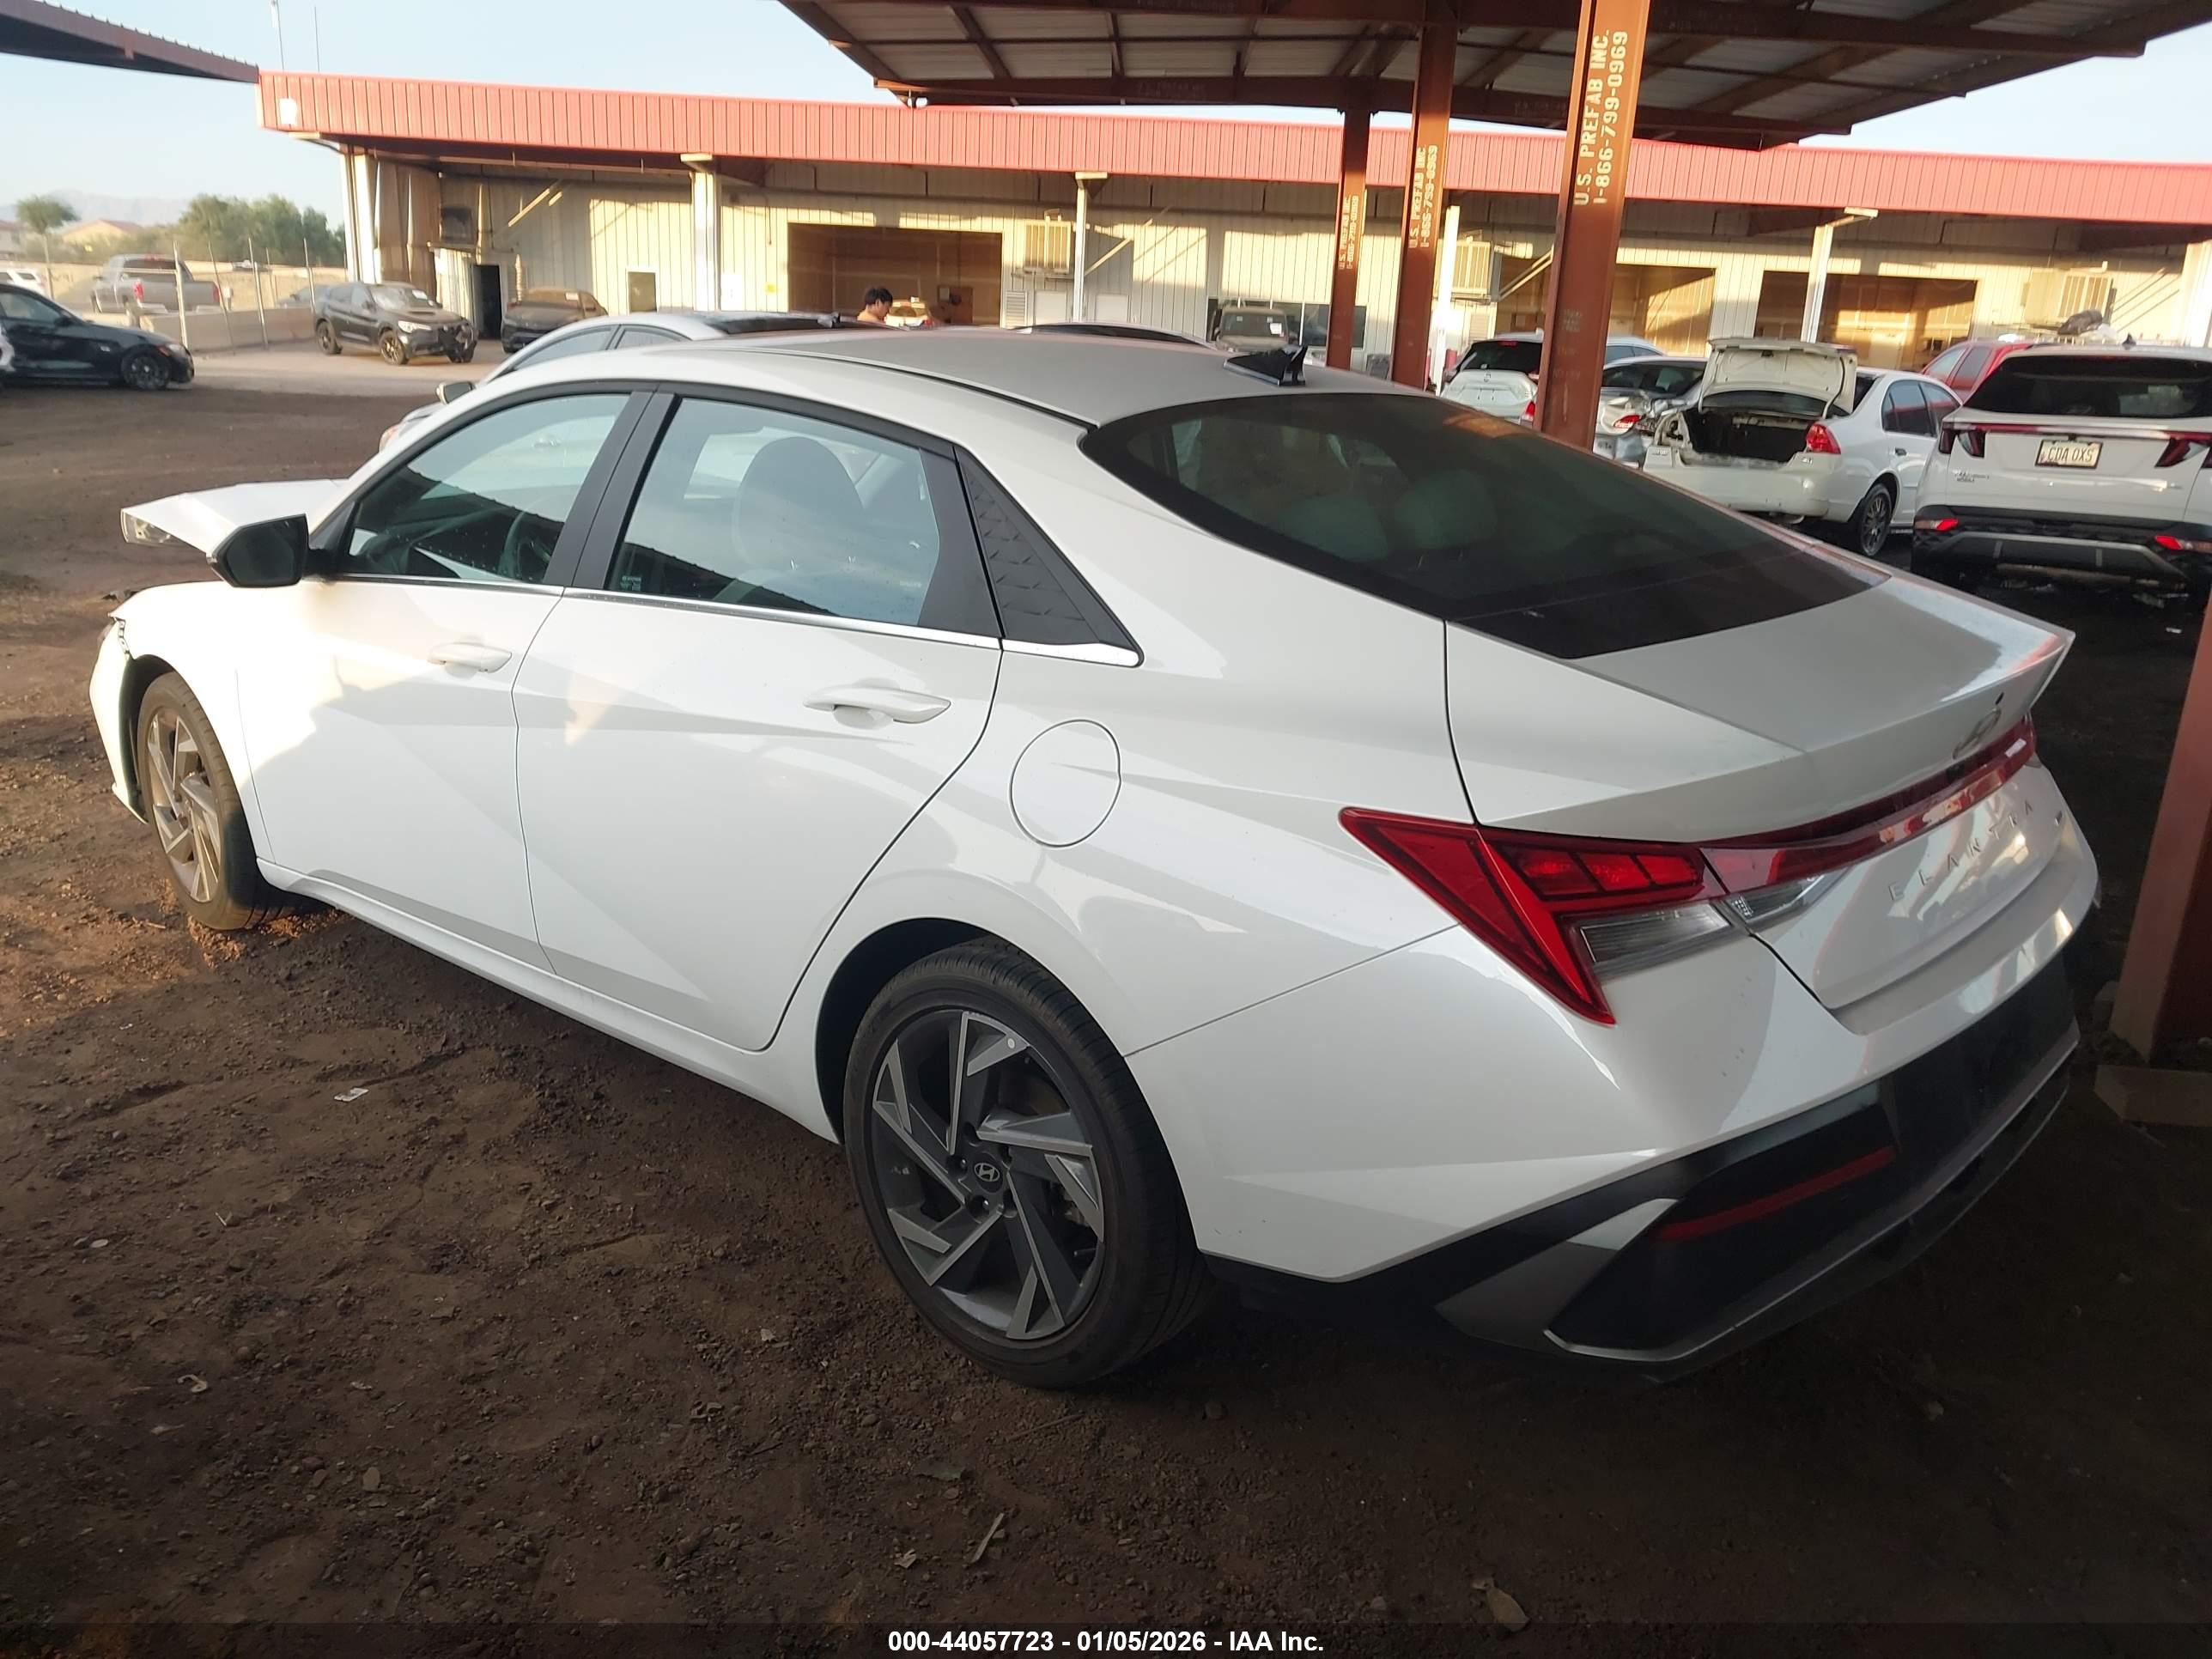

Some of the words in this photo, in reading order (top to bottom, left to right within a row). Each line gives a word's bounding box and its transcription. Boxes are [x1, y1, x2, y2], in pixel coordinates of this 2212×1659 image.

[1589, 29, 1609, 70] INC.
[1579, 78, 1603, 158] PREFAB
[1593, 31, 1628, 204] 1-866-799-0969
[1574, 167, 1593, 205] U.S.
[1889, 799, 2034, 901] ELANTRA
